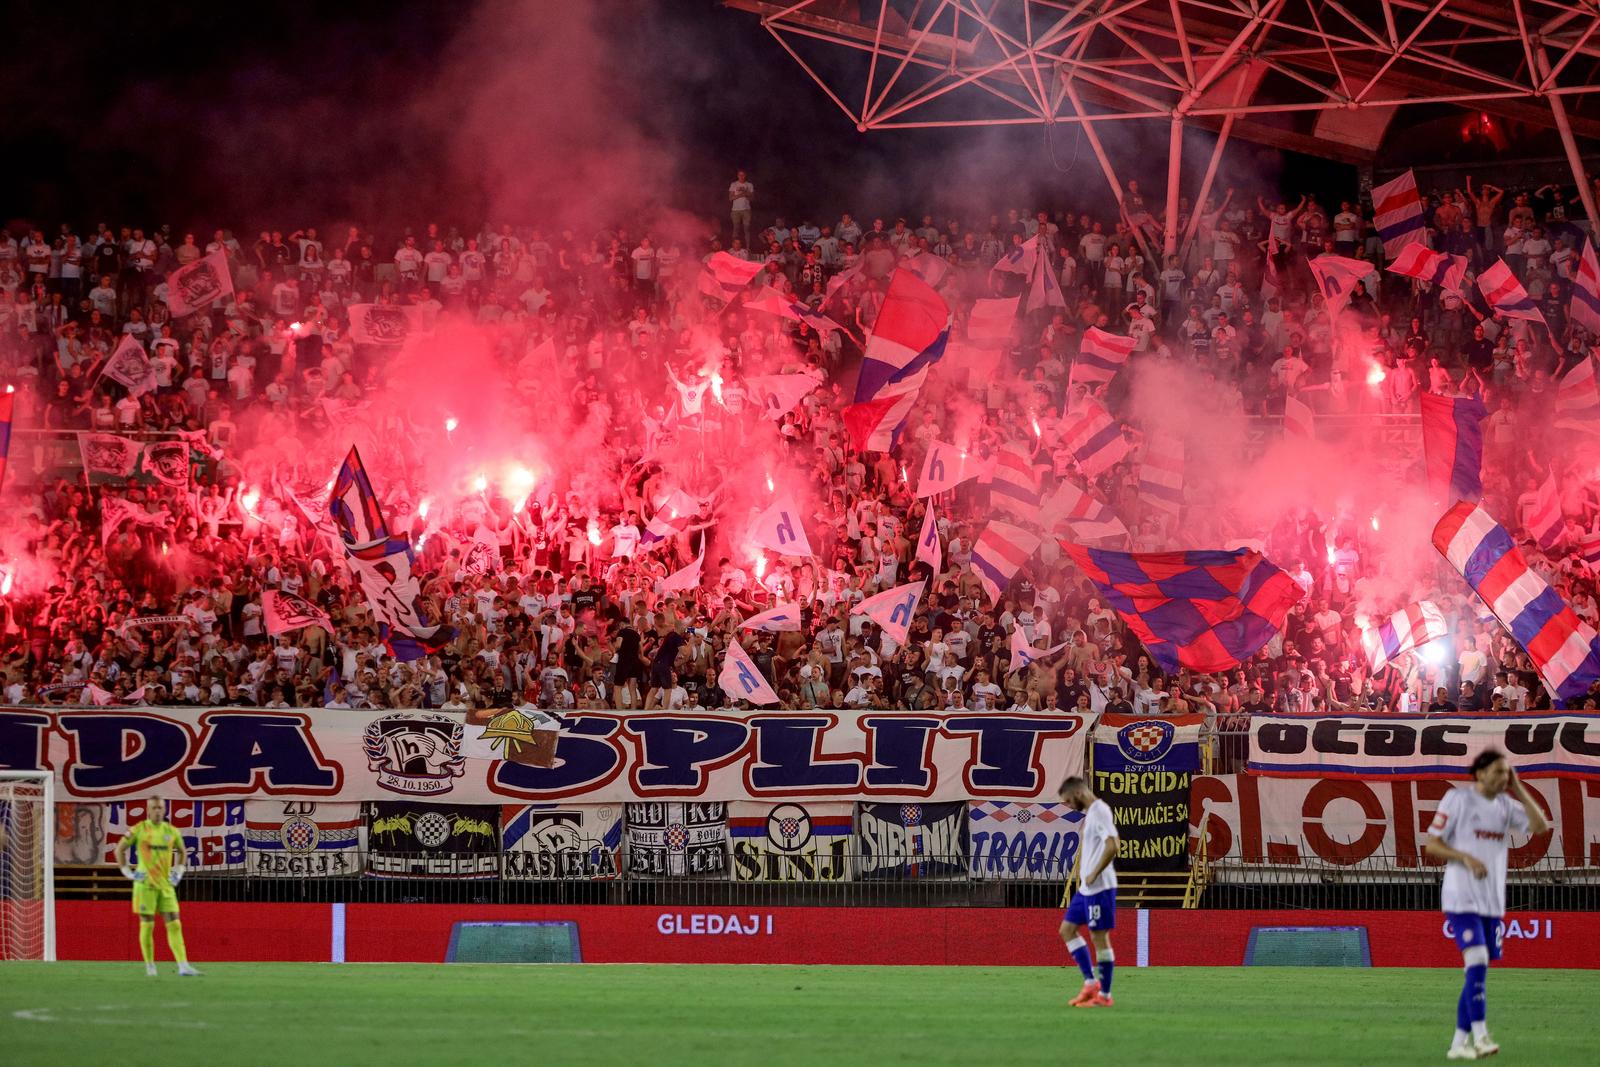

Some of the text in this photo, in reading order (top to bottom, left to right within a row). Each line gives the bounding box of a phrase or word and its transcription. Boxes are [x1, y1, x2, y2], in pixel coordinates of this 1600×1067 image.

[1095, 771, 1189, 794] TORCIDA
[106, 800, 245, 828] TOCIDA
[1114, 802, 1188, 826] NAVIJAČE SA
[105, 832, 247, 866] ZREB
[735, 838, 847, 880] SINJ
[972, 831, 1080, 873] TROGIR
[257, 852, 349, 874] REGIJA
[1088, 904, 1101, 920] 19
[657, 914, 773, 935] GLEDAJ I
[1442, 919, 1540, 939] GAJ
